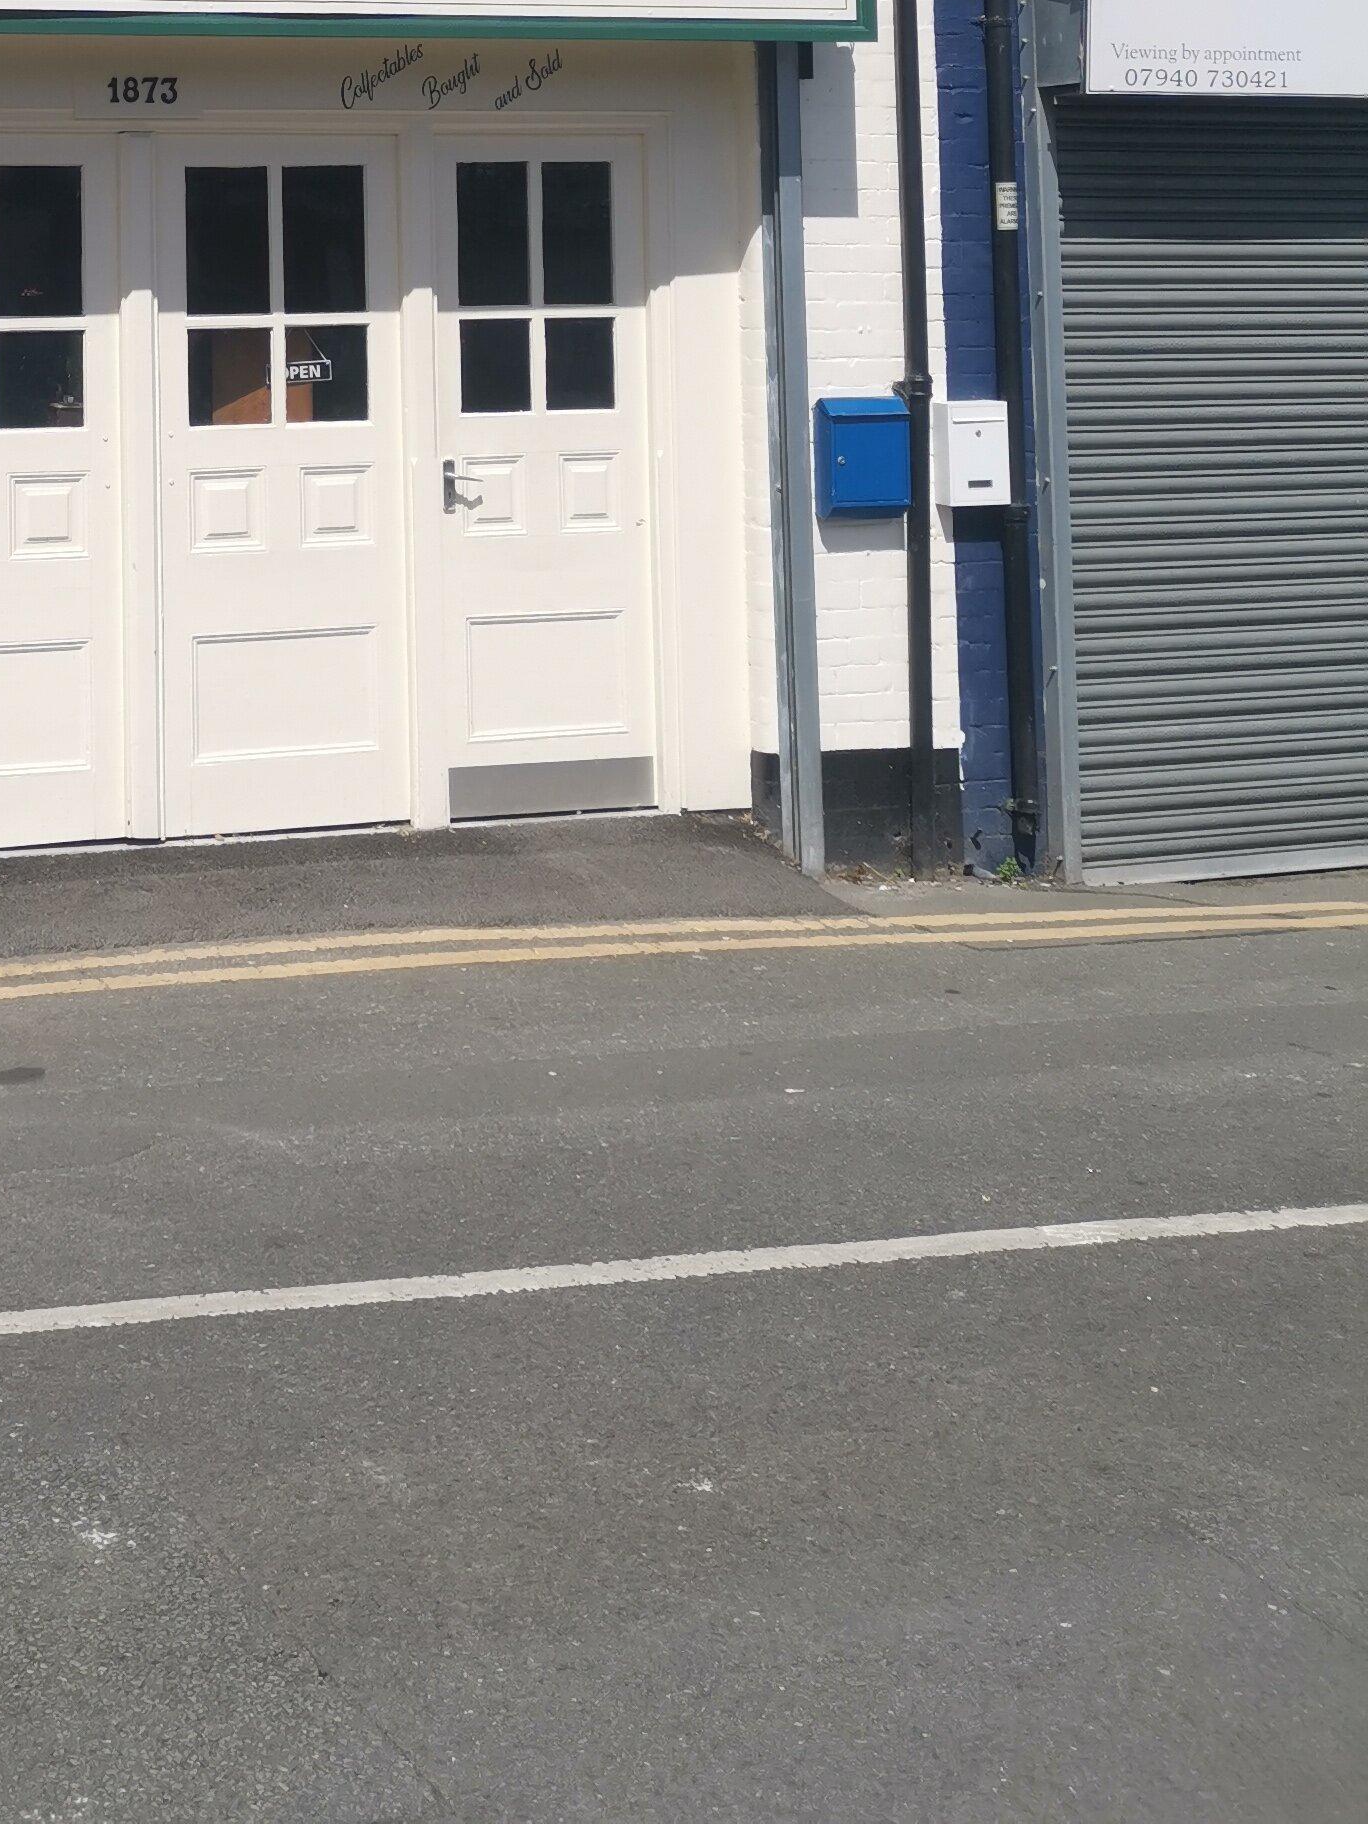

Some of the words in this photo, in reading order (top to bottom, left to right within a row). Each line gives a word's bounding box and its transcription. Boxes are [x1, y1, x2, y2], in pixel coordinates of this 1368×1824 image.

[1111, 42, 1178, 62] Viewing
[1182, 43, 1201, 63] by
[1203, 46, 1303, 65] appointment
[341, 43, 425, 110] Collectables
[421, 52, 481, 110] Bought
[494, 75, 522, 111] and
[525, 48, 563, 90] Sold
[1124, 68, 1198, 87] 07940
[1207, 69, 1288, 89] 730421
[106, 76, 179, 105] 1873
[285, 364, 321, 380] PEN
